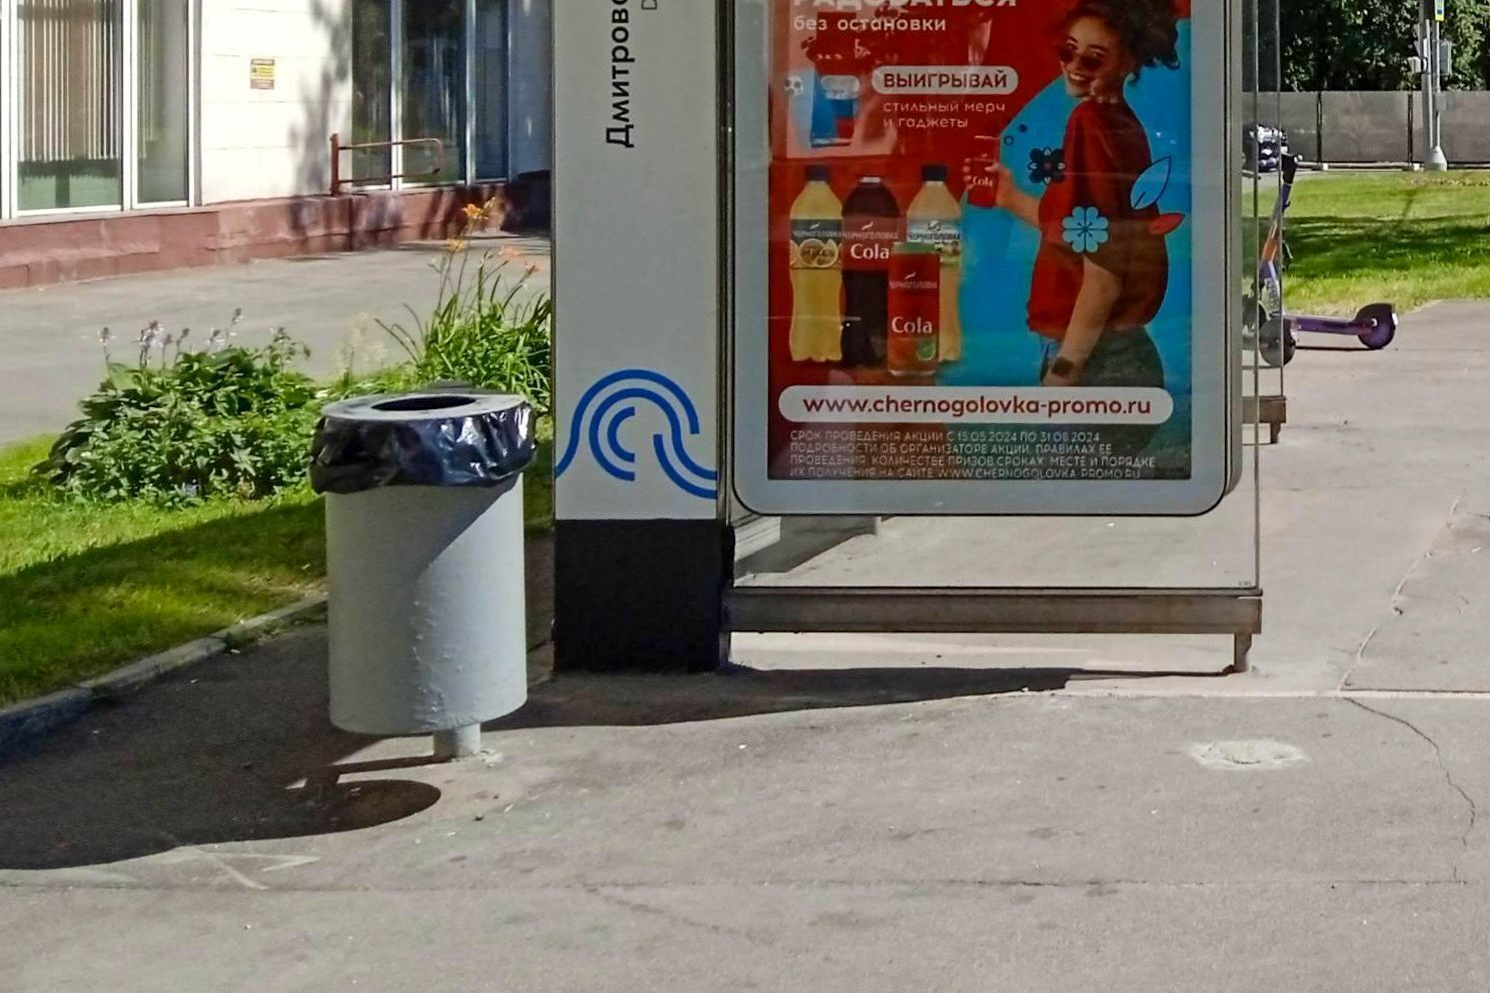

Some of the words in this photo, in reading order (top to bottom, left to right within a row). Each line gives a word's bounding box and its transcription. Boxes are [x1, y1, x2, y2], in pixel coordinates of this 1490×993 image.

[793, 15, 828, 32] без
[836, 17, 946, 32] остановки
[883, 69, 1007, 89] ВЫИГРЫВАЙ
[882, 101, 959, 113] стильный
[964, 103, 1006, 115] мерч
[883, 119, 893, 128] и
[898, 117, 969, 129] гаджеты
[850, 243, 890, 260] Cola
[891, 316, 933, 334] Cola
[802, 394, 1152, 419] www.chernogolovka-promo.ru
[790, 430, 821, 441] СРОК
[825, 430, 900, 441] ПРОВЕДЕНИЯ
[904, 430, 943, 441] АКЦИИ
[1019, 431, 1037, 442] ПО
[790, 443, 878, 453] ПОДРОБНОСТИ
[881, 443, 898, 453] ОБ
[901, 444, 988, 454] ОРГАНИЗАТОРЕ
[1036, 444, 1095, 454] ПРАВИЛАХ
[1050, 456, 1086, 467] МЕСТЕ
